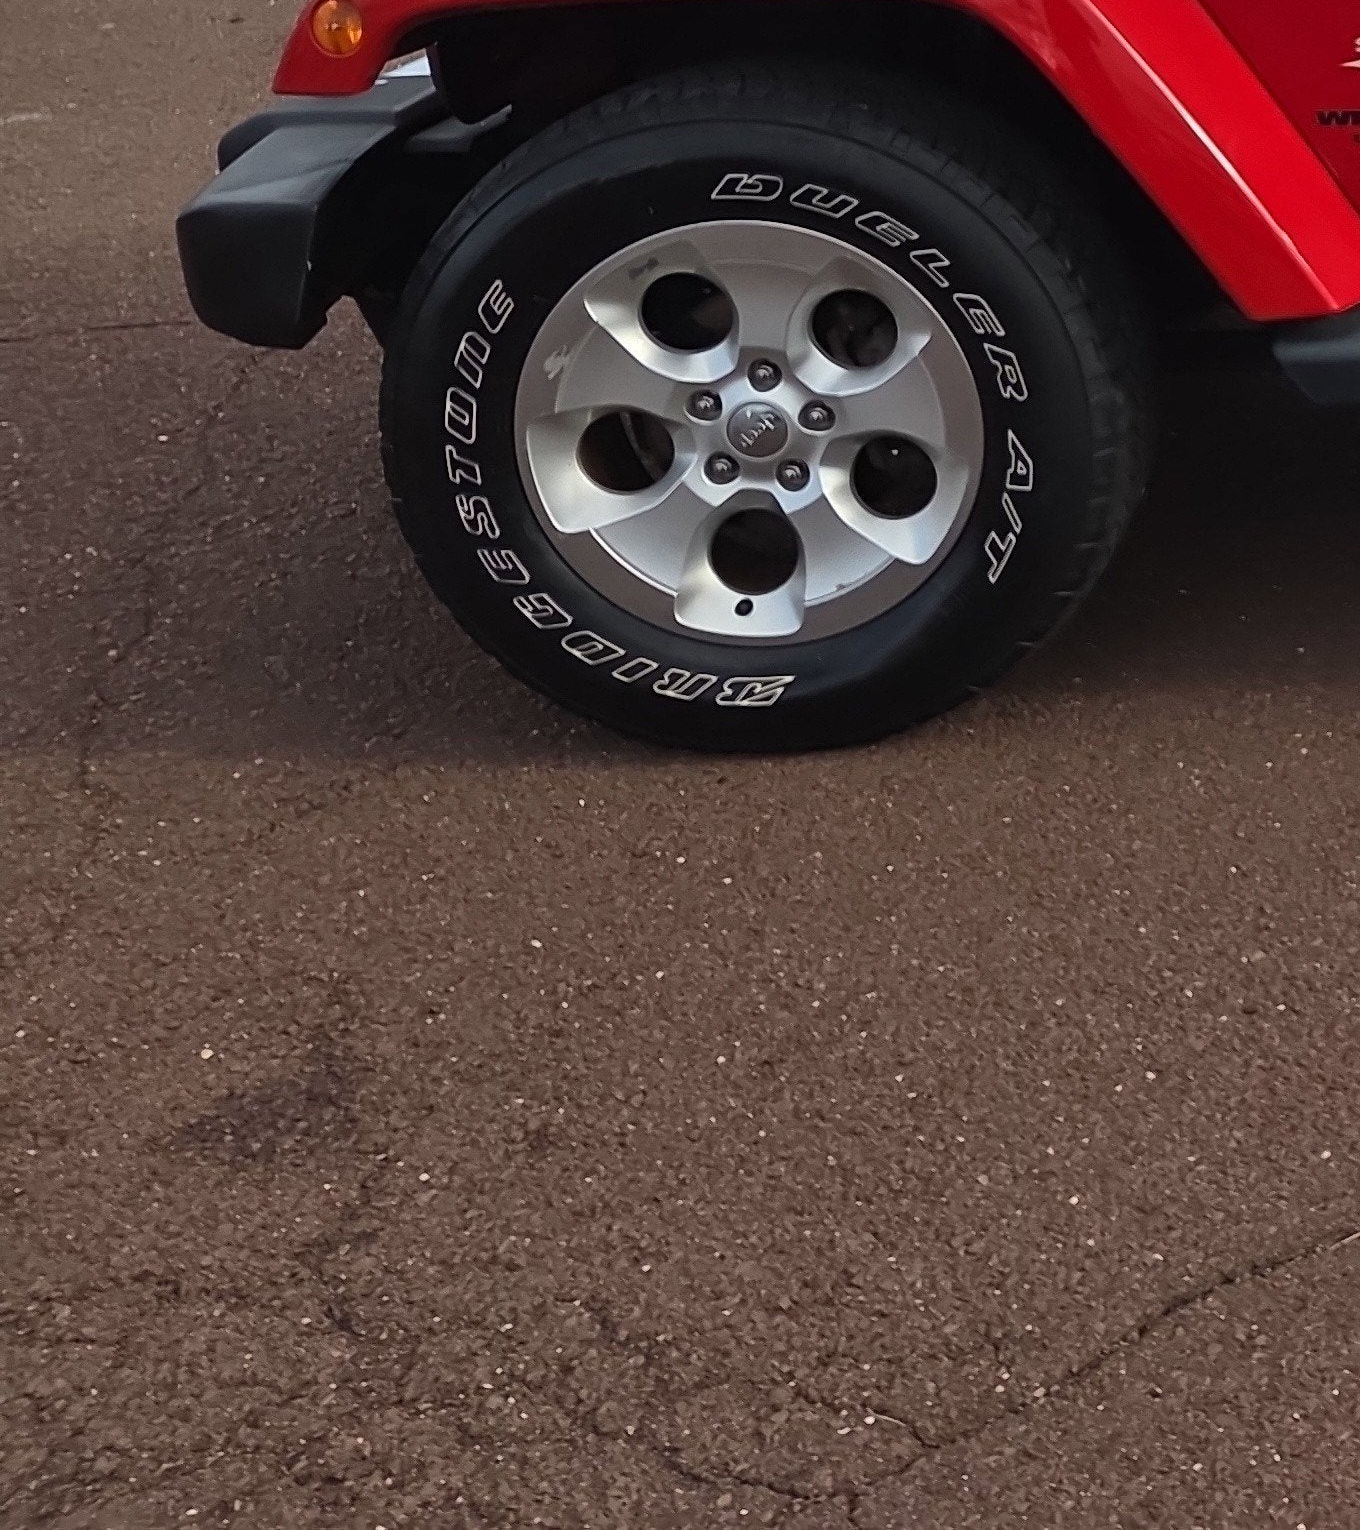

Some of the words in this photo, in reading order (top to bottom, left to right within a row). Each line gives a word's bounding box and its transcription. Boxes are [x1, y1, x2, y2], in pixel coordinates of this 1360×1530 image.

[444, 279, 796, 707] BRIDGESTONE
[711, 172, 1030, 403] DUELER
[983, 429, 1034, 584] A/T
